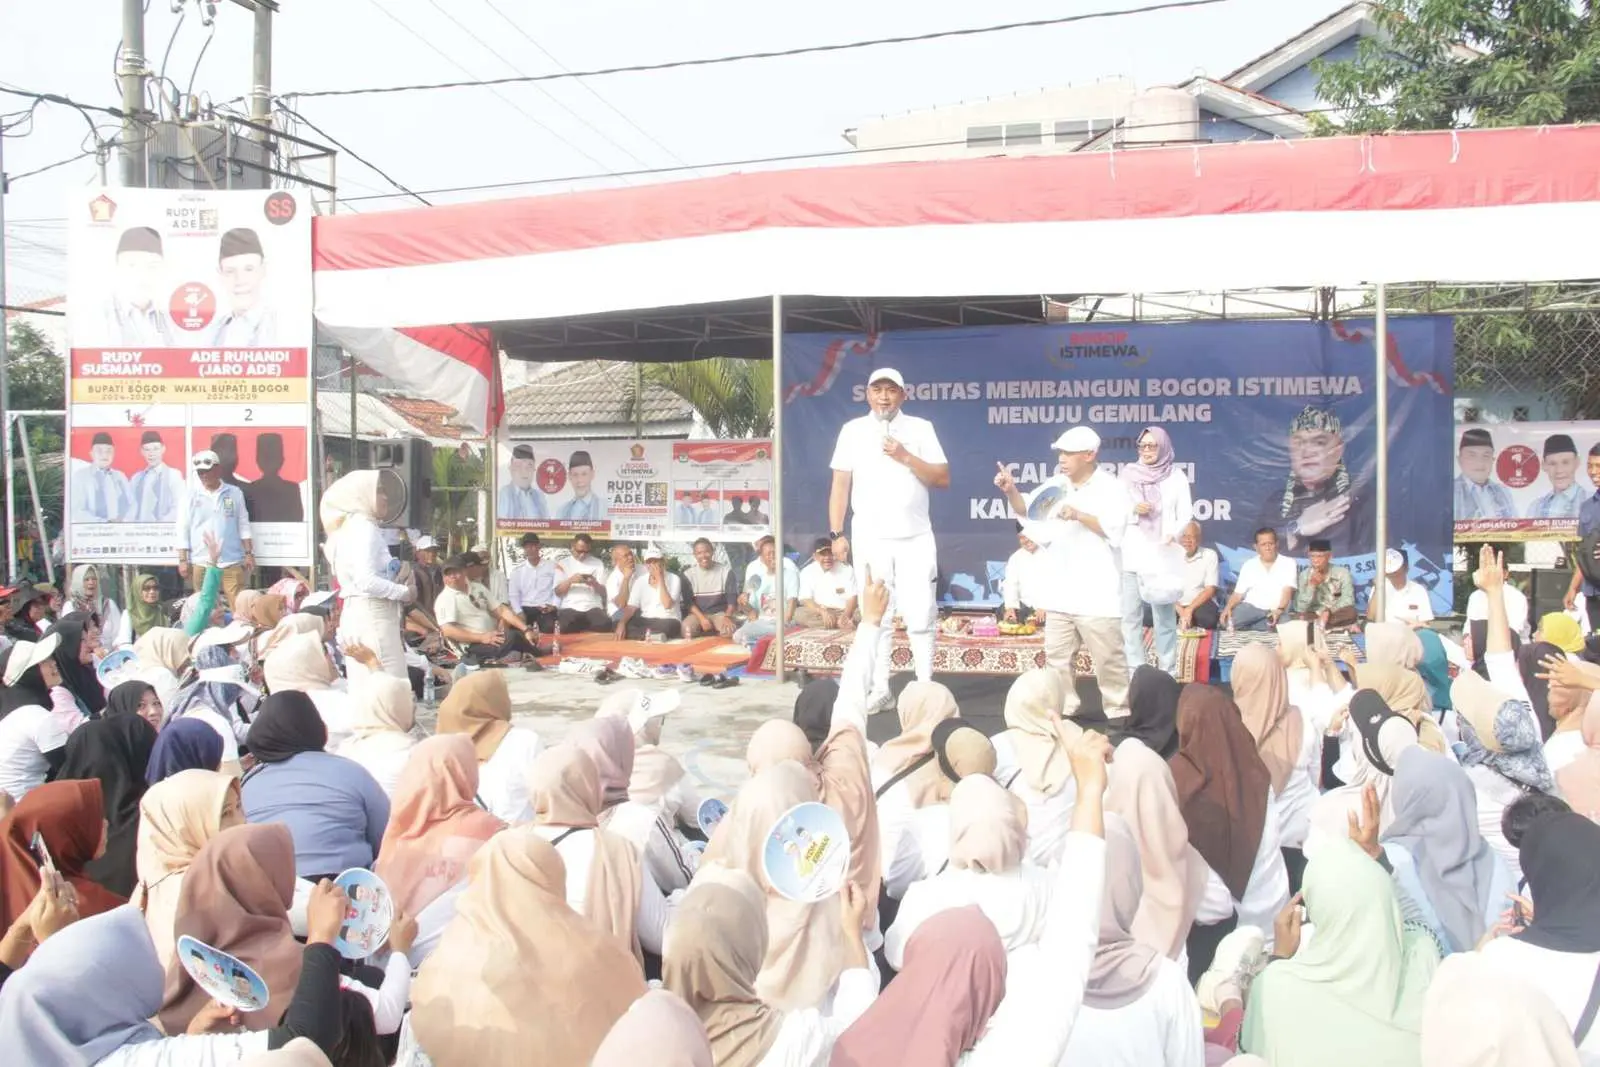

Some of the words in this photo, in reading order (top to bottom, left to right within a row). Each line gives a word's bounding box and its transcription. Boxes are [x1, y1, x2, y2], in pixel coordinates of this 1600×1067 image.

[166, 207, 196, 217] RUDY
[269, 198, 293, 218] SS
[172, 219, 197, 229] ADE
[101, 351, 143, 363] RUDY
[190, 351, 221, 362] ADE
[223, 350, 290, 362] RUHANDI
[1060, 345, 1139, 358] ISTIMEWA
[81, 363, 163, 376] SUSMANTO
[198, 363, 242, 377] (JARO
[246, 363, 282, 377] ADE)
[88, 385, 124, 393] BUPATI
[128, 384, 167, 393] BOGOR
[174, 384, 207, 393] WAKIL
[211, 384, 248, 393] BUPATI
[251, 384, 290, 393] BOGOR
[852, 381, 980, 402] SRGITAS
[985, 379, 1140, 399] MEMBANGUN
[1147, 377, 1232, 397] BOGOR
[1237, 376, 1363, 396] ISTIMEWA
[244, 408, 254, 422] 2
[987, 404, 1083, 424] MENUJU
[1088, 403, 1212, 423] GEMILANG
[607, 480, 643, 490] RUDY
[613, 493, 643, 504] ADE
